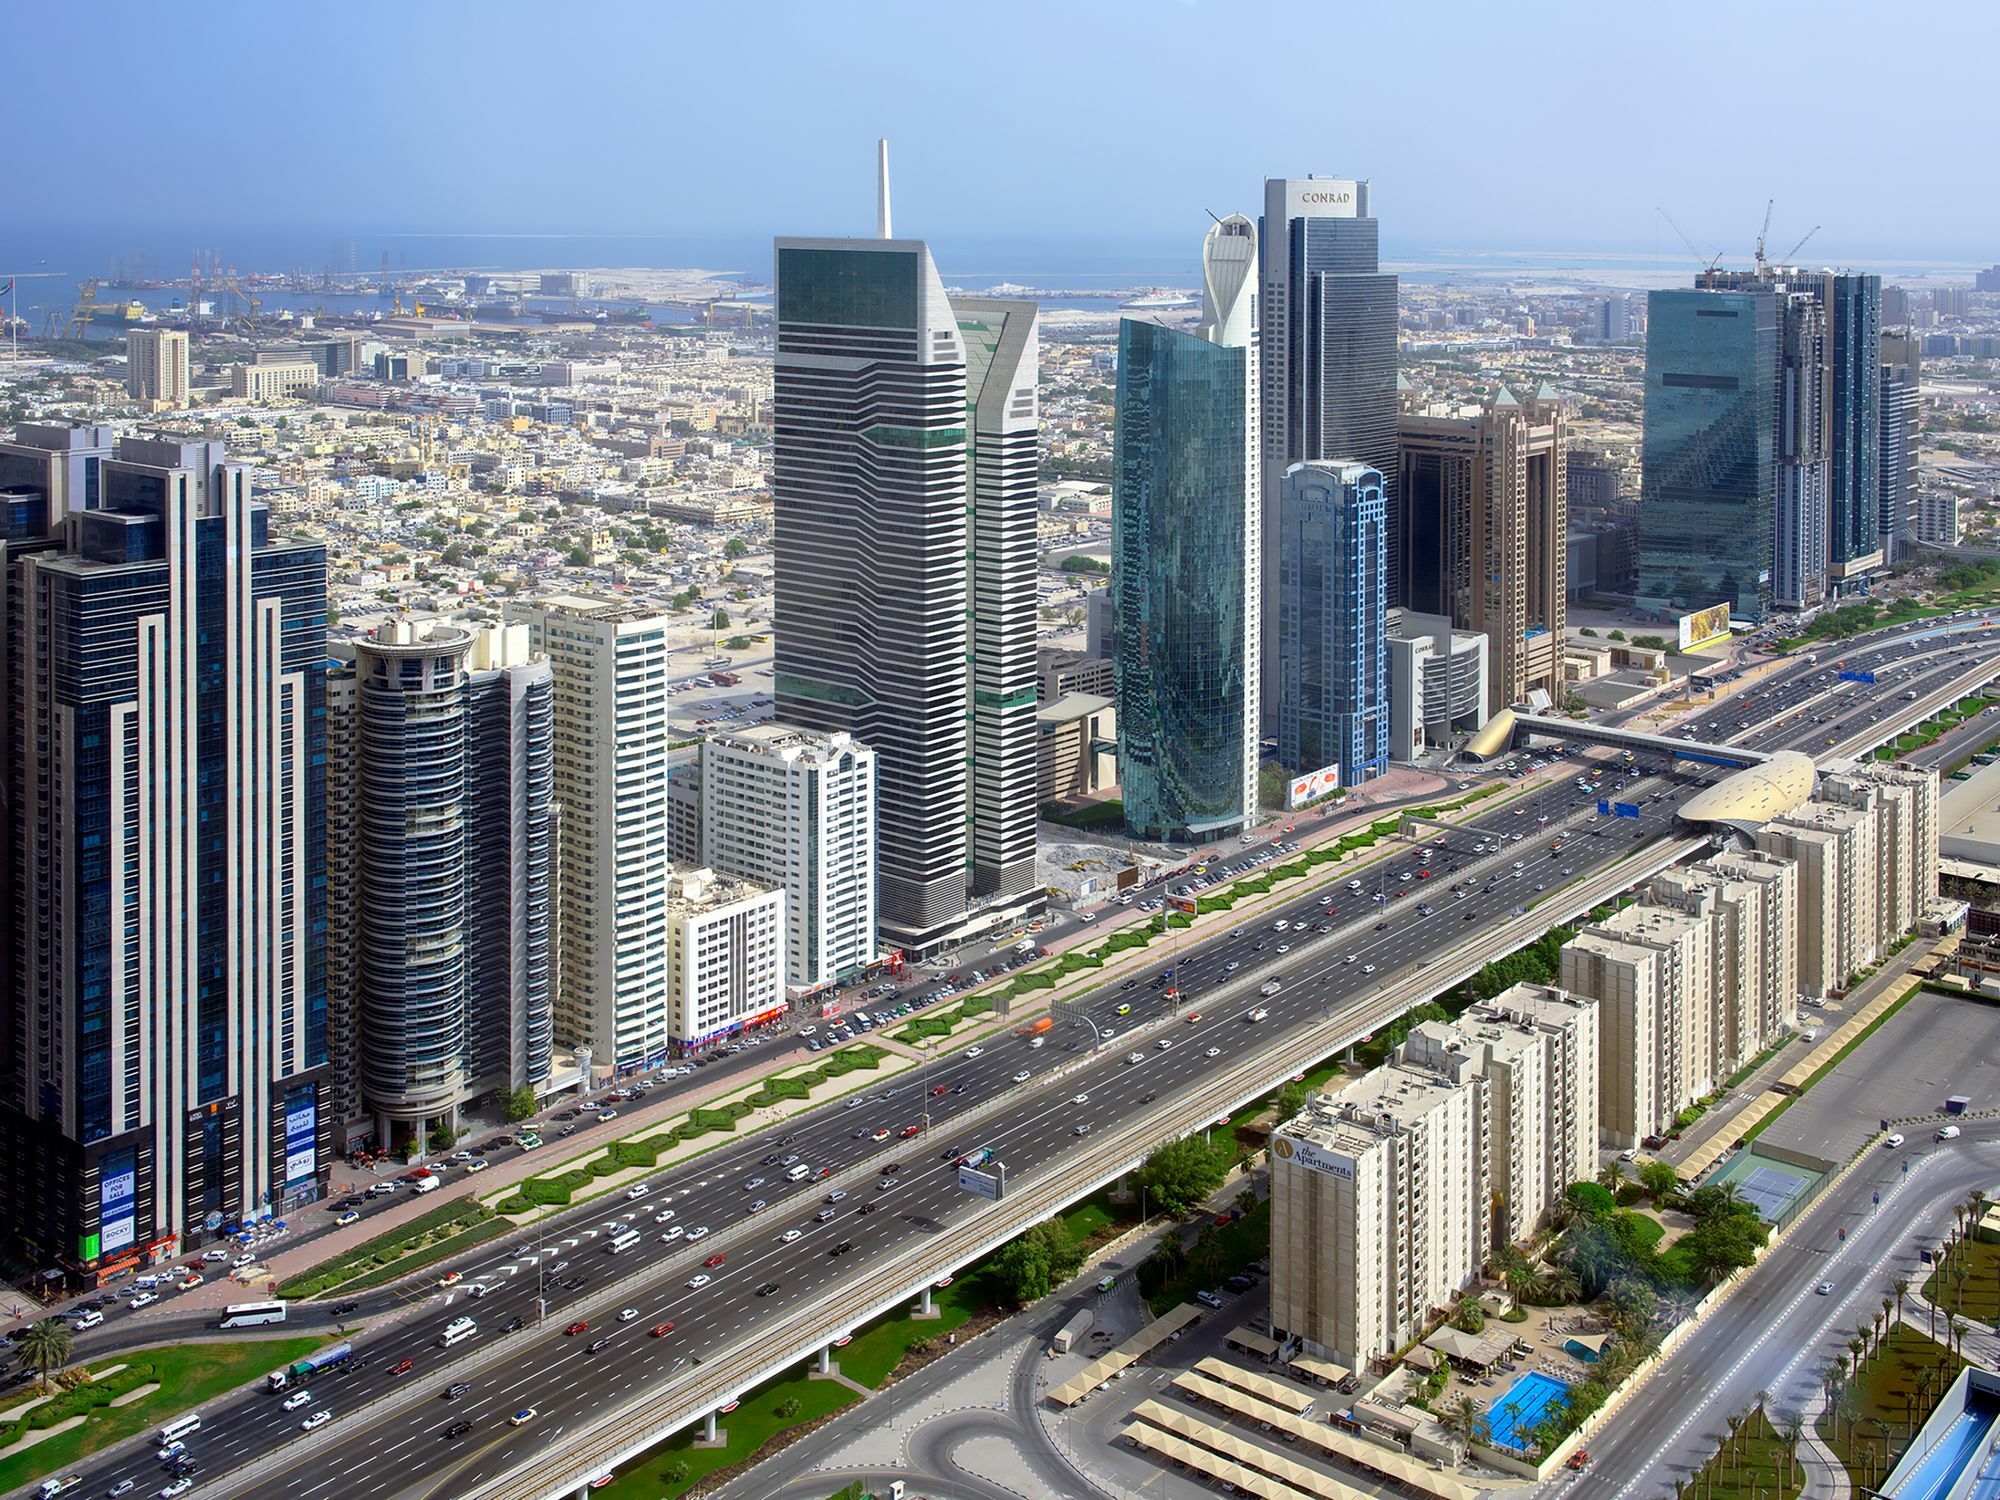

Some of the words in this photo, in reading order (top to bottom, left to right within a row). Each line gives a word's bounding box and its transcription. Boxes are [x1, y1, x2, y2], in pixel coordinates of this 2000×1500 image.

[1302, 192, 1350, 204] CONRAD
[1301, 1146, 1316, 1158] the
[1294, 1151, 1352, 1177] Apartments
[104, 1175, 130, 1188] OFFICES
[111, 1184, 123, 1193] FOR
[109, 1191, 124, 1200] SALE
[105, 1226, 129, 1239] ROCKY
